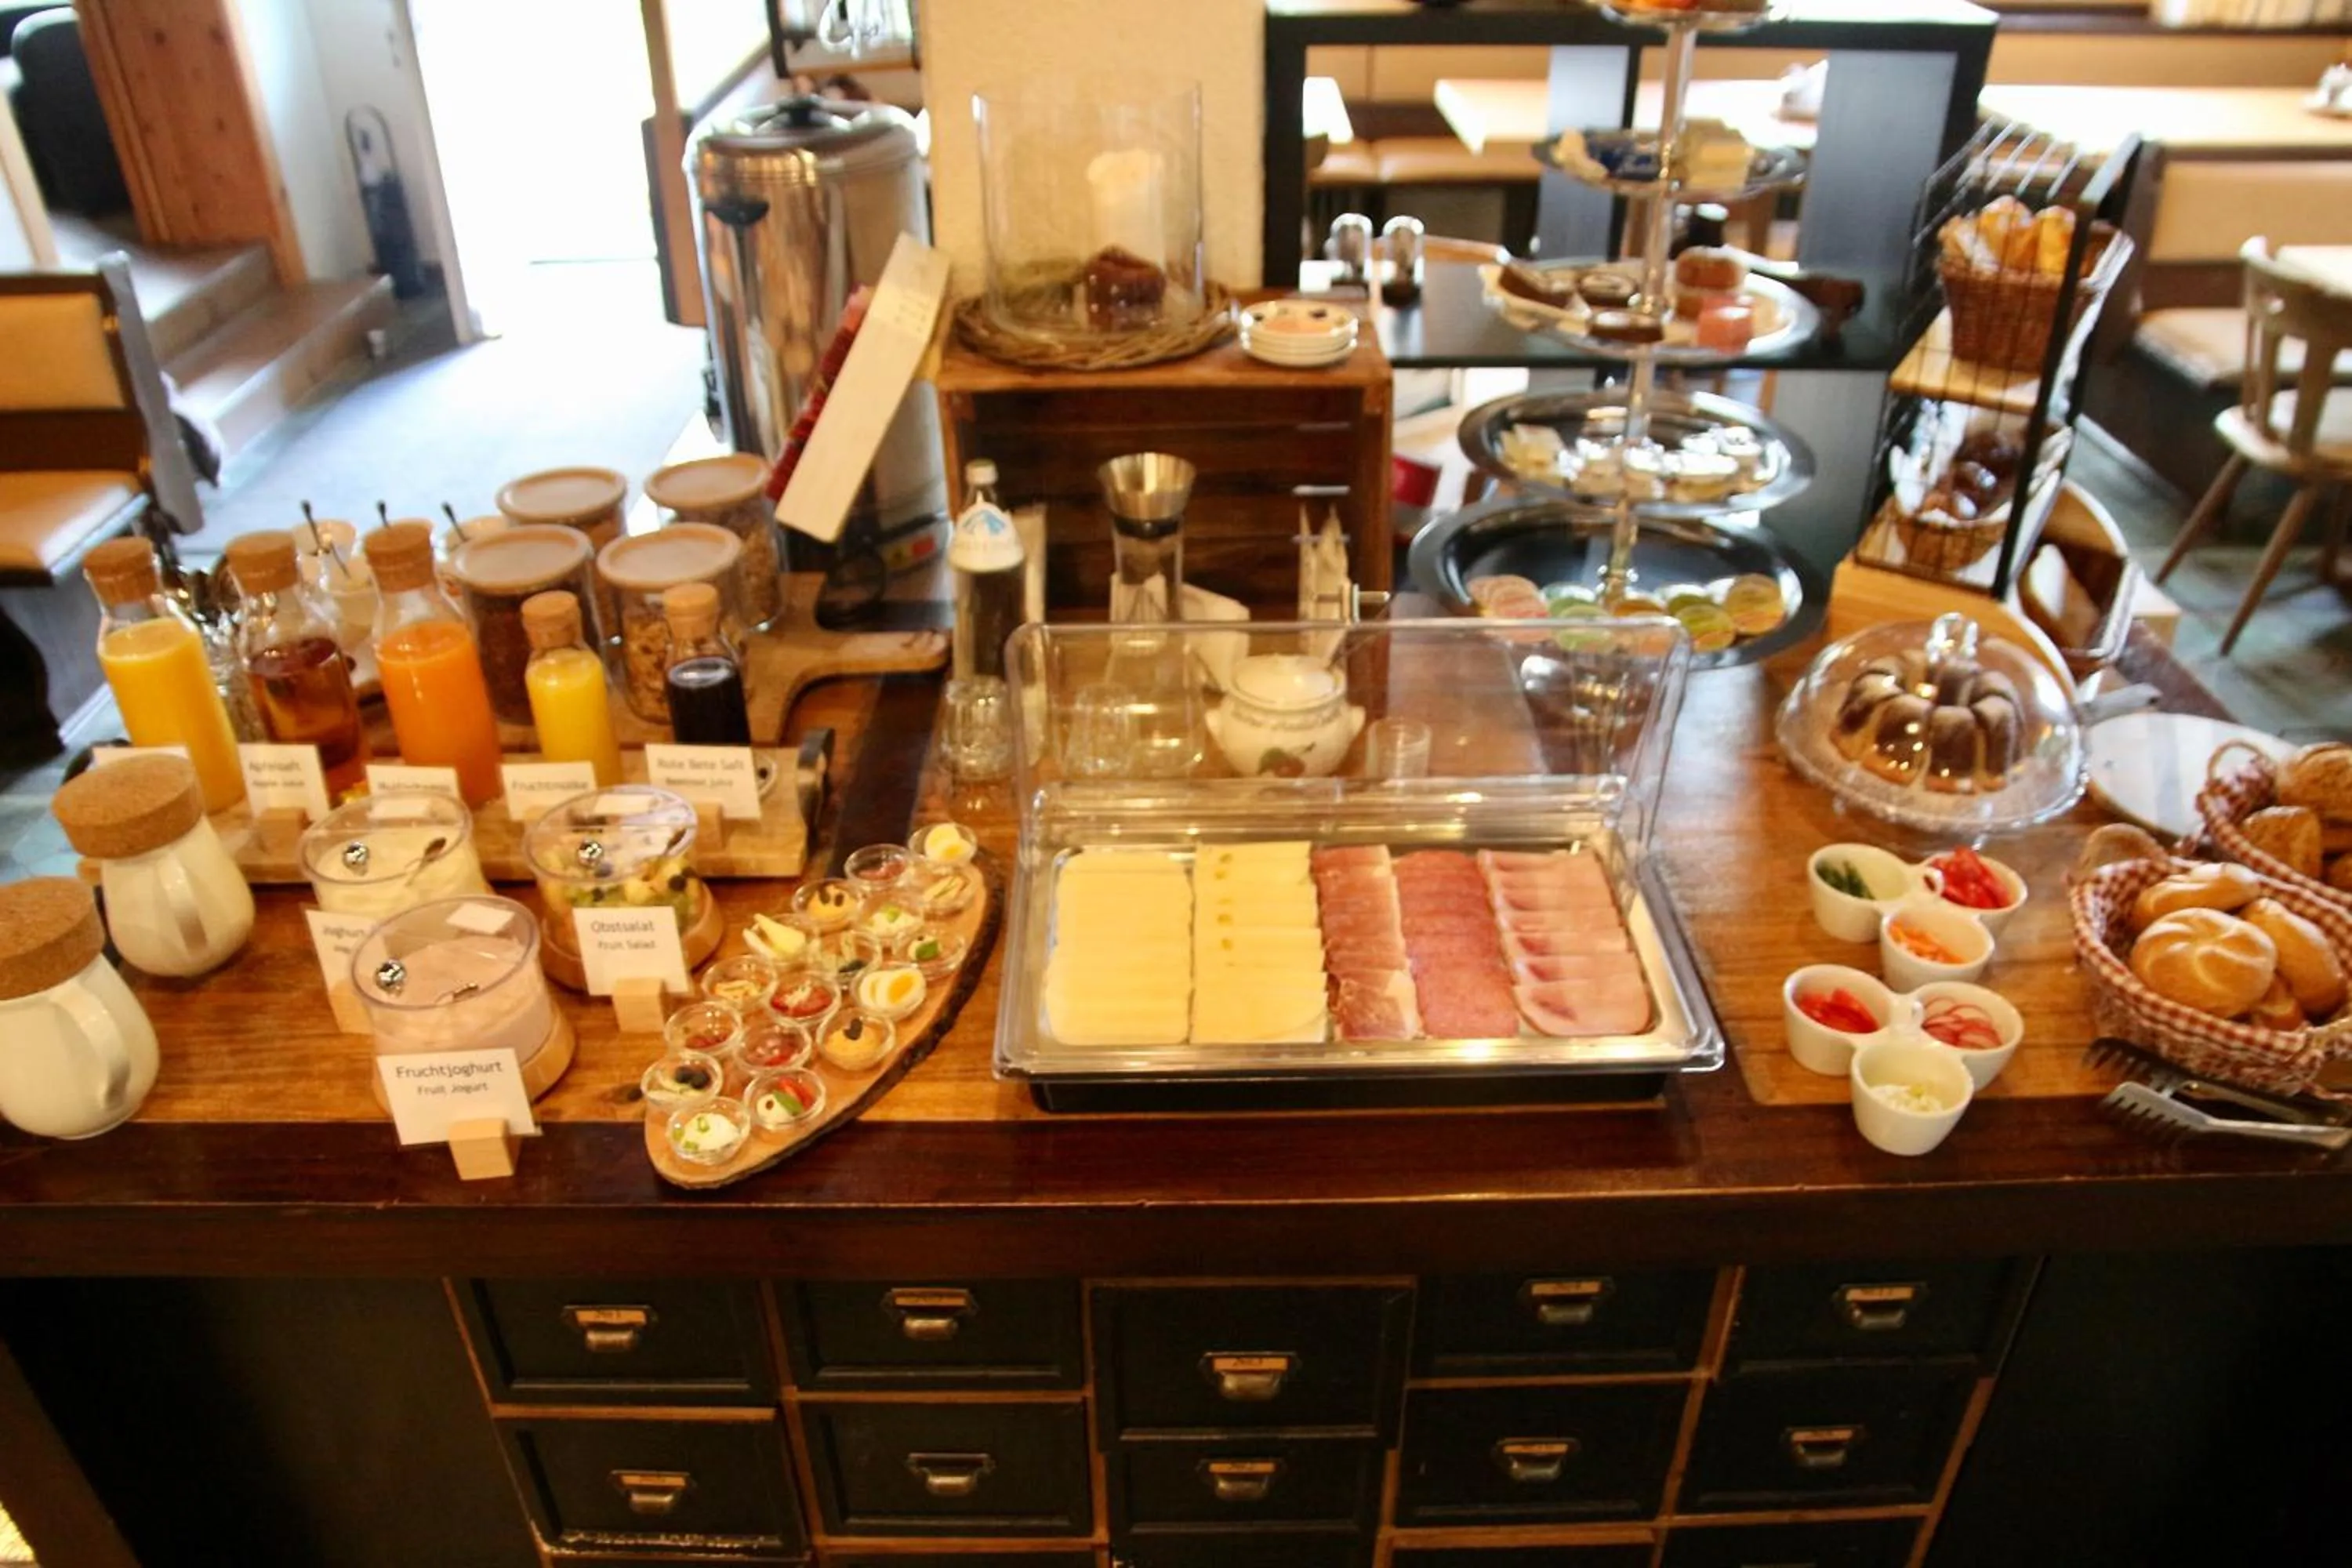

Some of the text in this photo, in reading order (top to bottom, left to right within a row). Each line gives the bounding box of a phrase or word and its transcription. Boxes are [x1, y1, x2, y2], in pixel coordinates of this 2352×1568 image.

[590, 920, 656, 933] Obstsalat
[597, 939, 625, 951] Fruit
[395, 1062, 504, 1079] Fruchtjoghurt
[416, 1082, 489, 1095] Fruit Jogurt
